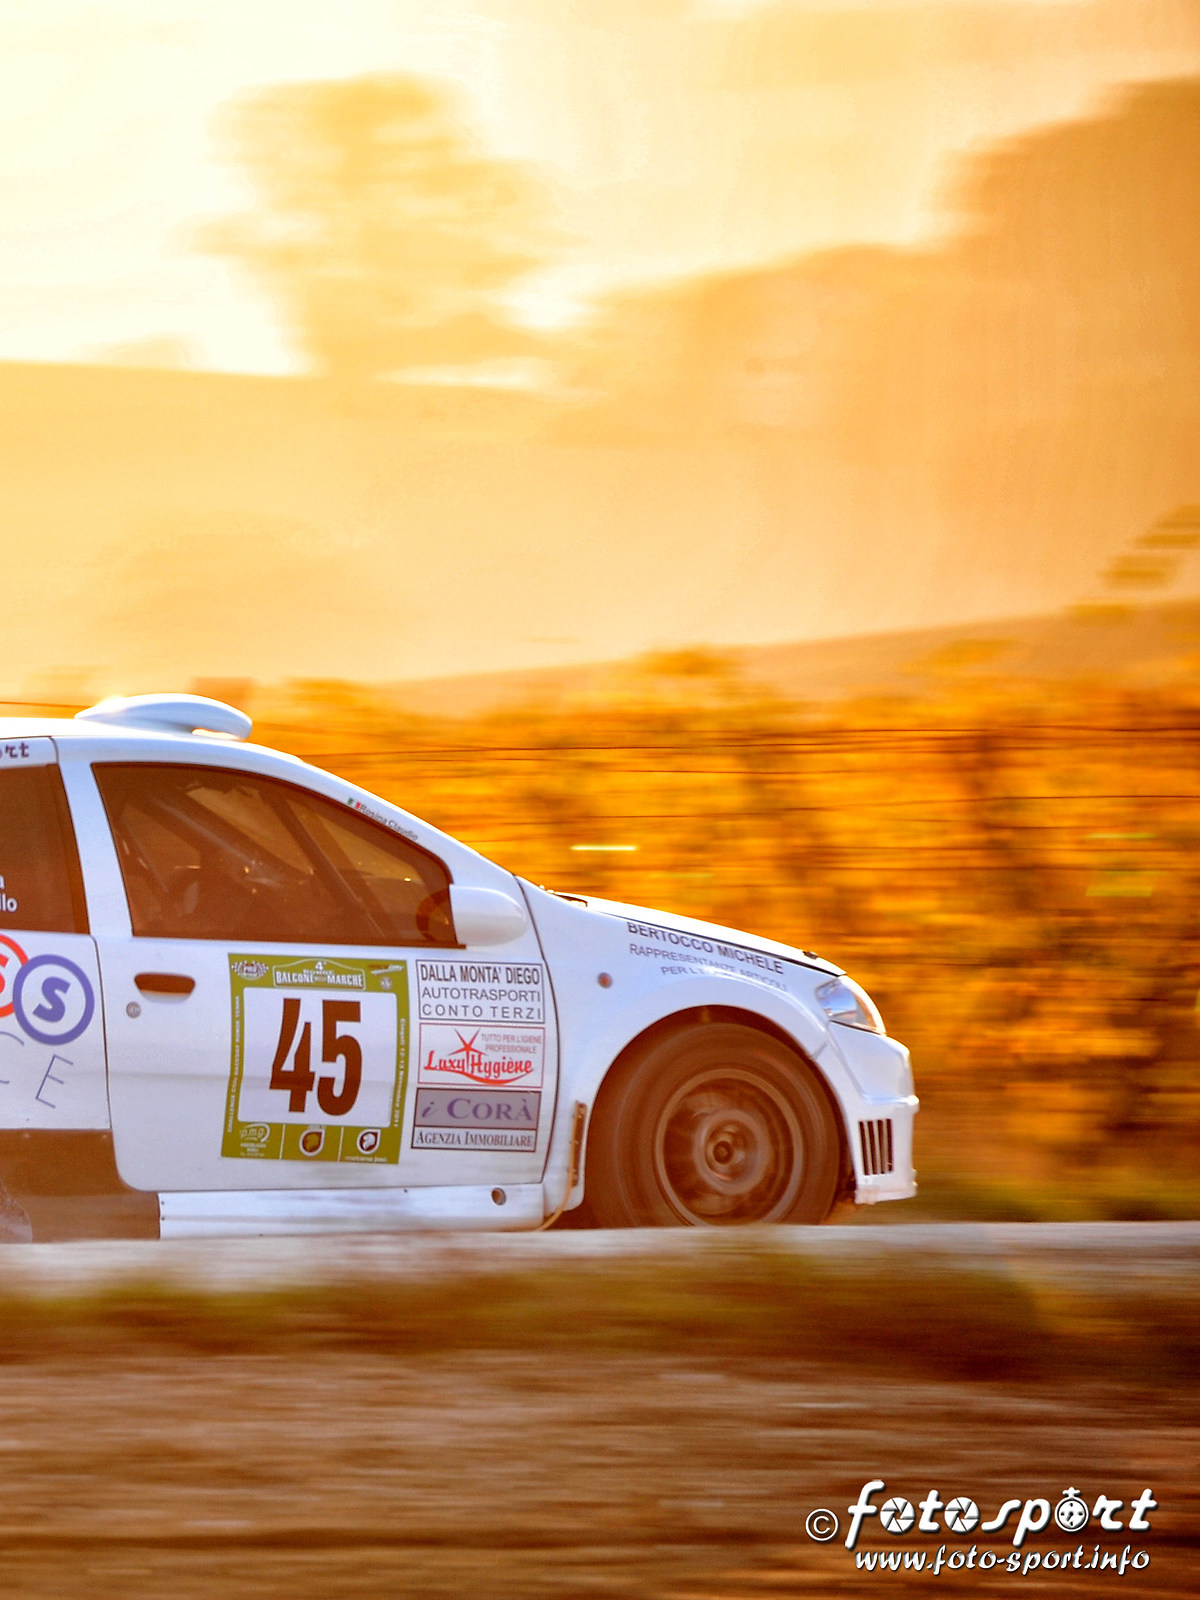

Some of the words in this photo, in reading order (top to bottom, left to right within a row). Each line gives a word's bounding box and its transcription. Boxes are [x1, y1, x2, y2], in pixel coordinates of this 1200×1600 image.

[627, 921, 714, 954] BERTOCCO
[717, 945, 785, 974] MICHELE
[276, 971, 315, 984] BALCONE
[327, 973, 364, 987] MARCHE
[420, 964, 457, 982] DALLA
[506, 968, 540, 985] DIEGO
[421, 986, 540, 1002] AUTOTRASPORTI
[422, 1004, 483, 1018] CONTO
[490, 1006, 541, 1020] TERZI
[269, 997, 363, 1117] 45
[424, 1050, 466, 1074] Luxy
